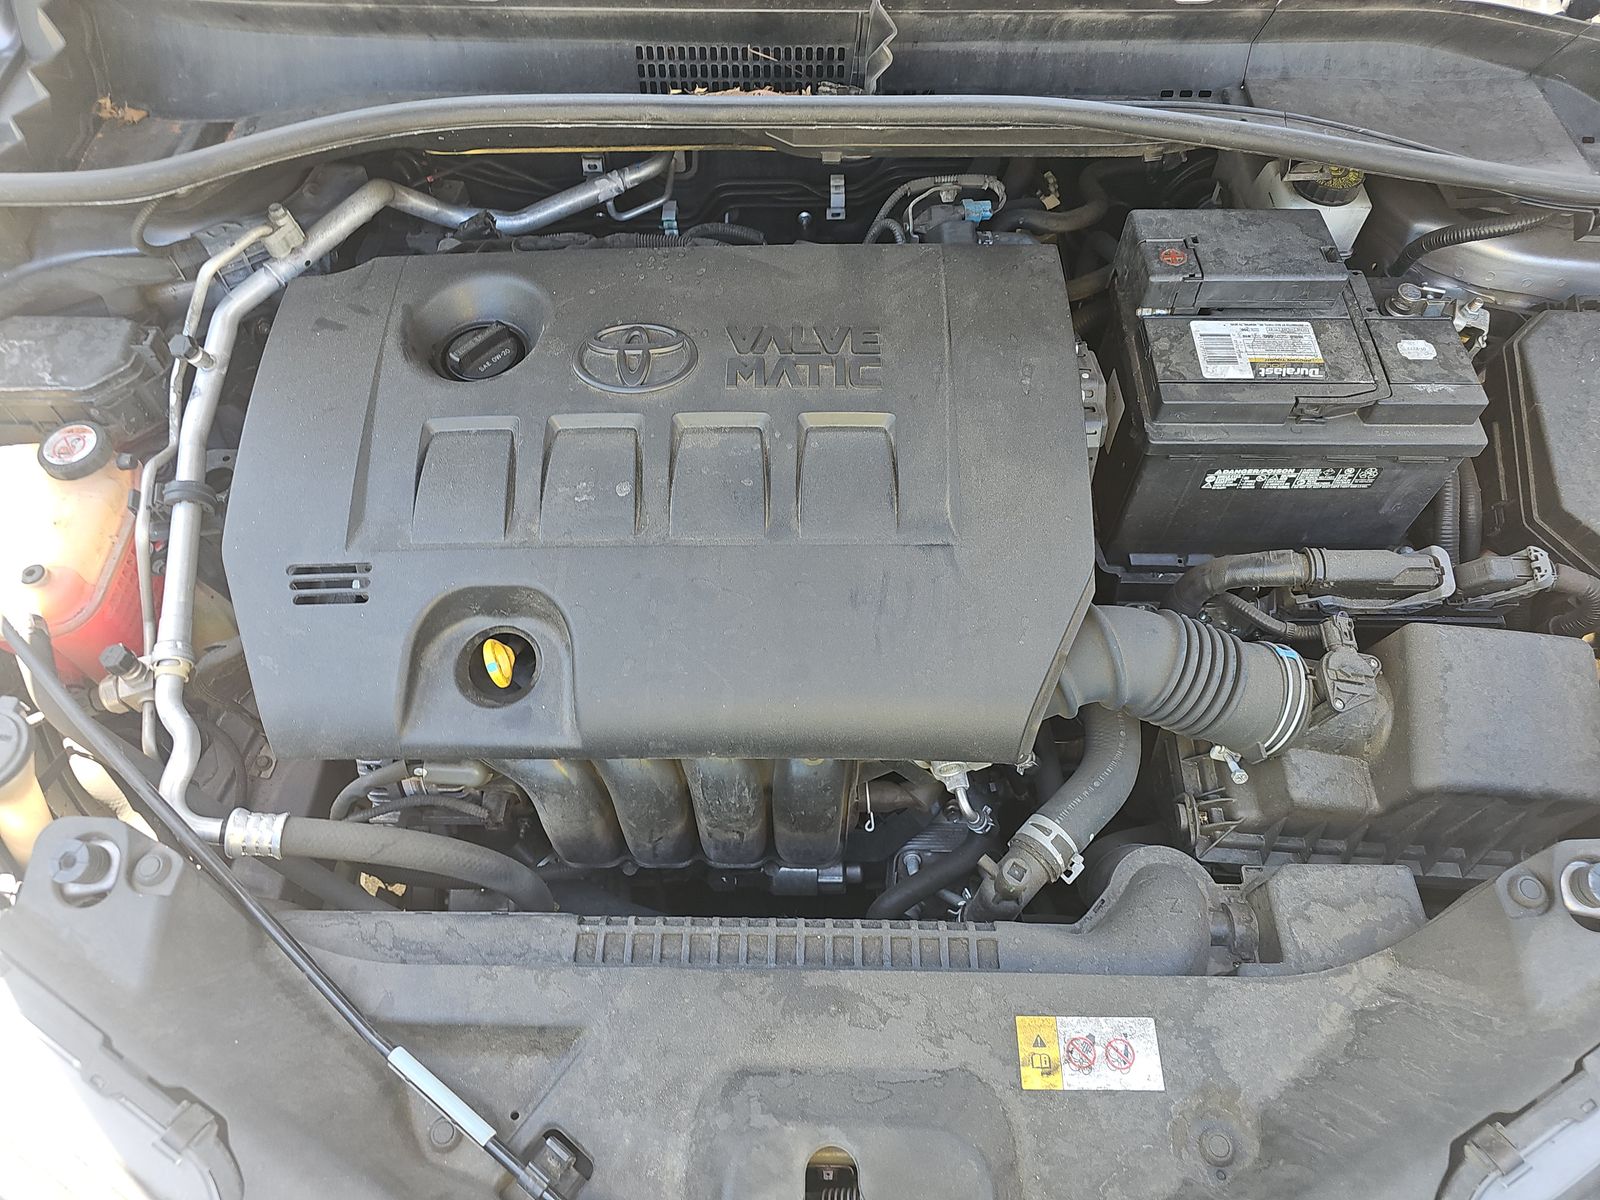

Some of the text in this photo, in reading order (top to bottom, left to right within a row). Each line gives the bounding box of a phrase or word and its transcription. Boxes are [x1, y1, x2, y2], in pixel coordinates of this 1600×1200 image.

[725, 326, 881, 355] VALVE
[478, 359, 492, 372] SAE
[725, 356, 882, 390] MATIC
[1259, 367, 1324, 378] Duralast
